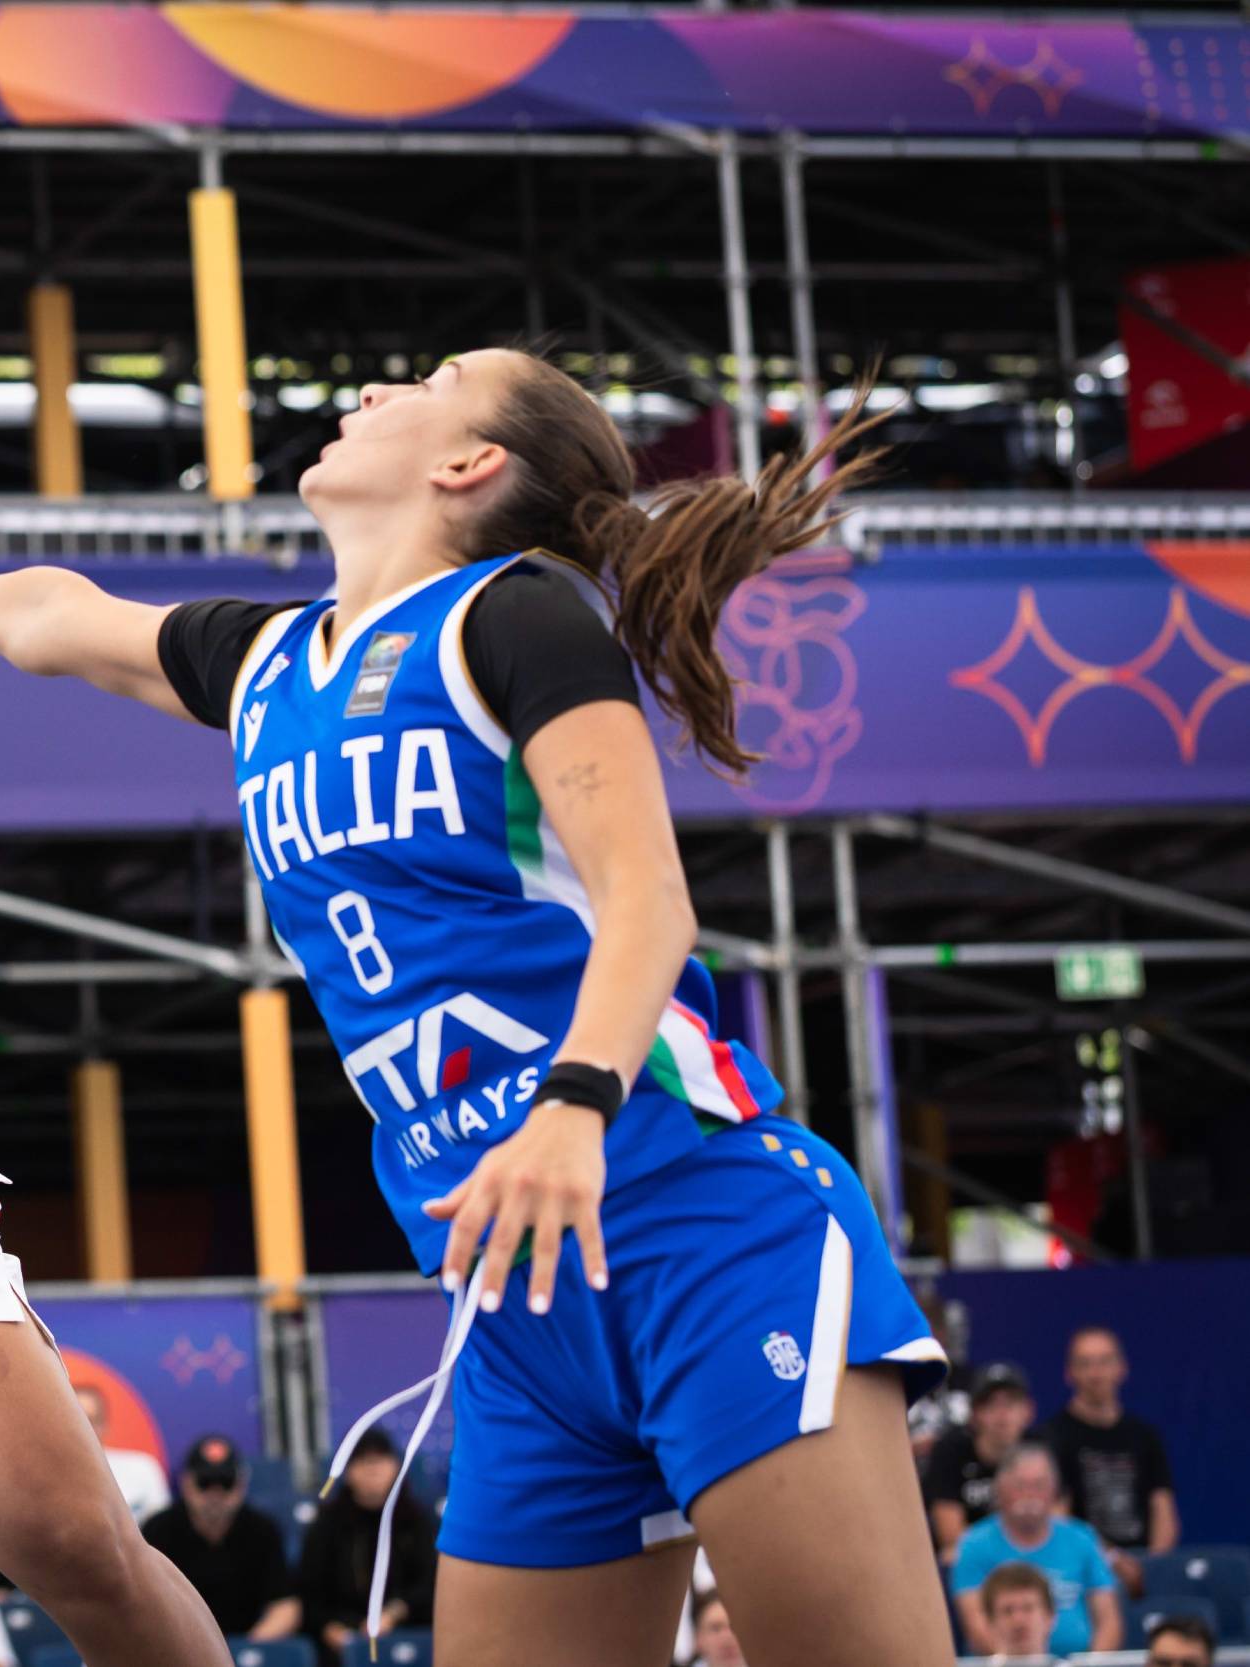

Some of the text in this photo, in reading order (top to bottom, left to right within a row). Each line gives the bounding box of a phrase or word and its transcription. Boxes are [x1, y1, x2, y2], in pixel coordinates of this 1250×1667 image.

[238, 728, 467, 882] TALIA
[327, 890, 394, 995] 8
[396, 1066, 539, 1169] AIRWAYS
